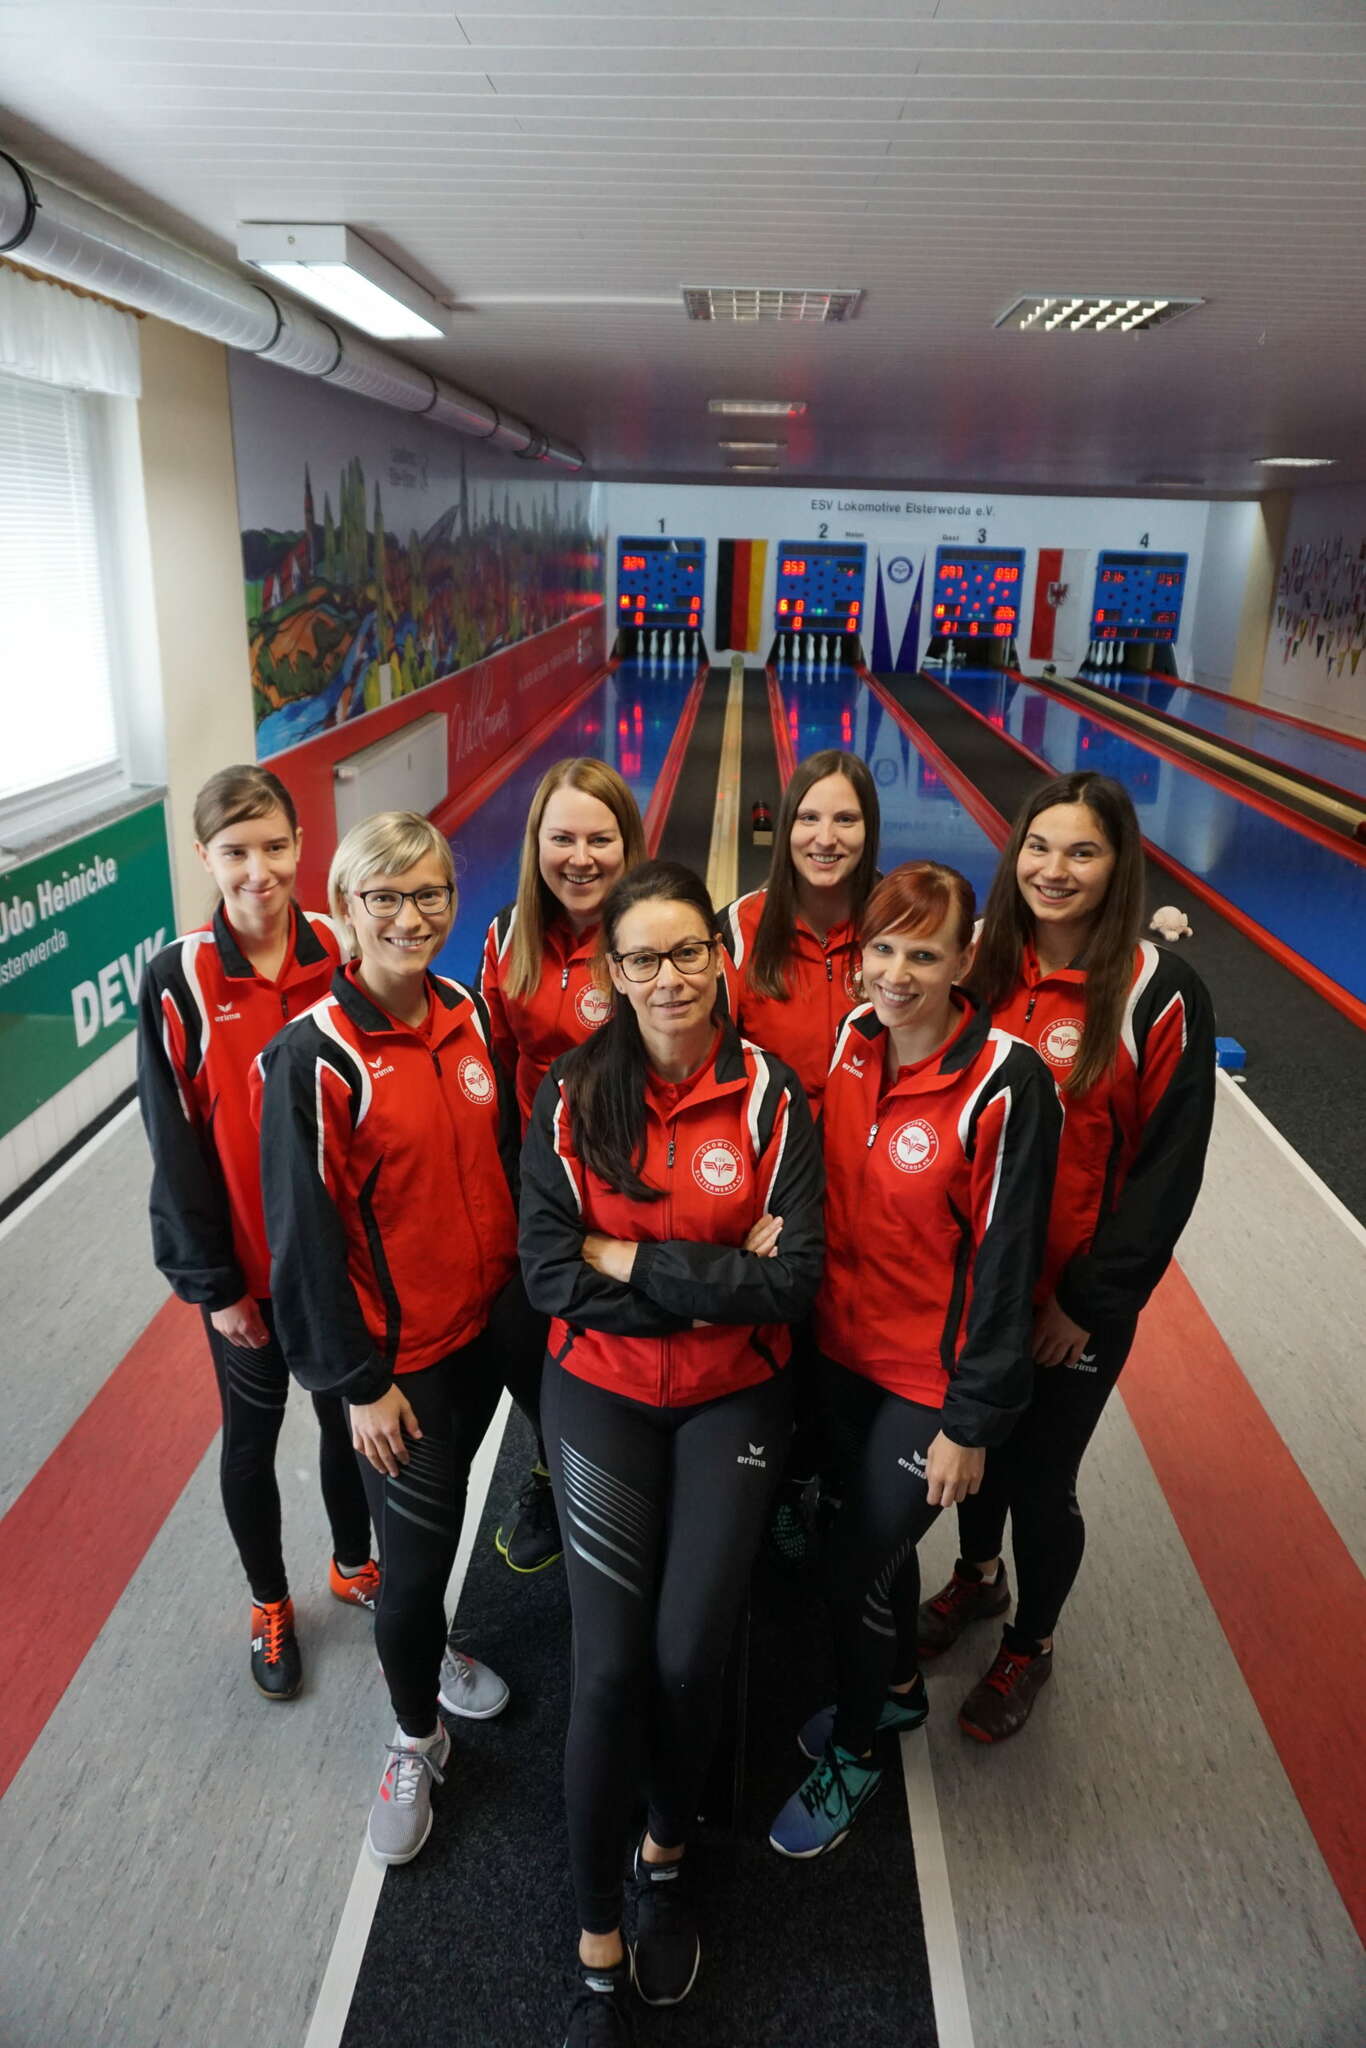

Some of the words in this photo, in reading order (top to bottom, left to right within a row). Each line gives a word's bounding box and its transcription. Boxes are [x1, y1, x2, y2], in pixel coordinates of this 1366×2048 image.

[811, 499, 834, 511] ESV
[837, 500, 901, 513] Lokomotive
[905, 502, 971, 516] Elsterwerda
[658, 517, 665, 533] 1
[819, 523, 829, 539] 2
[977, 528, 987, 543] 3
[1139, 532, 1150, 548] 4
[782, 560, 806, 576] 353
[37, 855, 118, 921] Heinicke
[0, 927, 67, 984] sterwerda
[736, 1455, 767, 1468] erima
